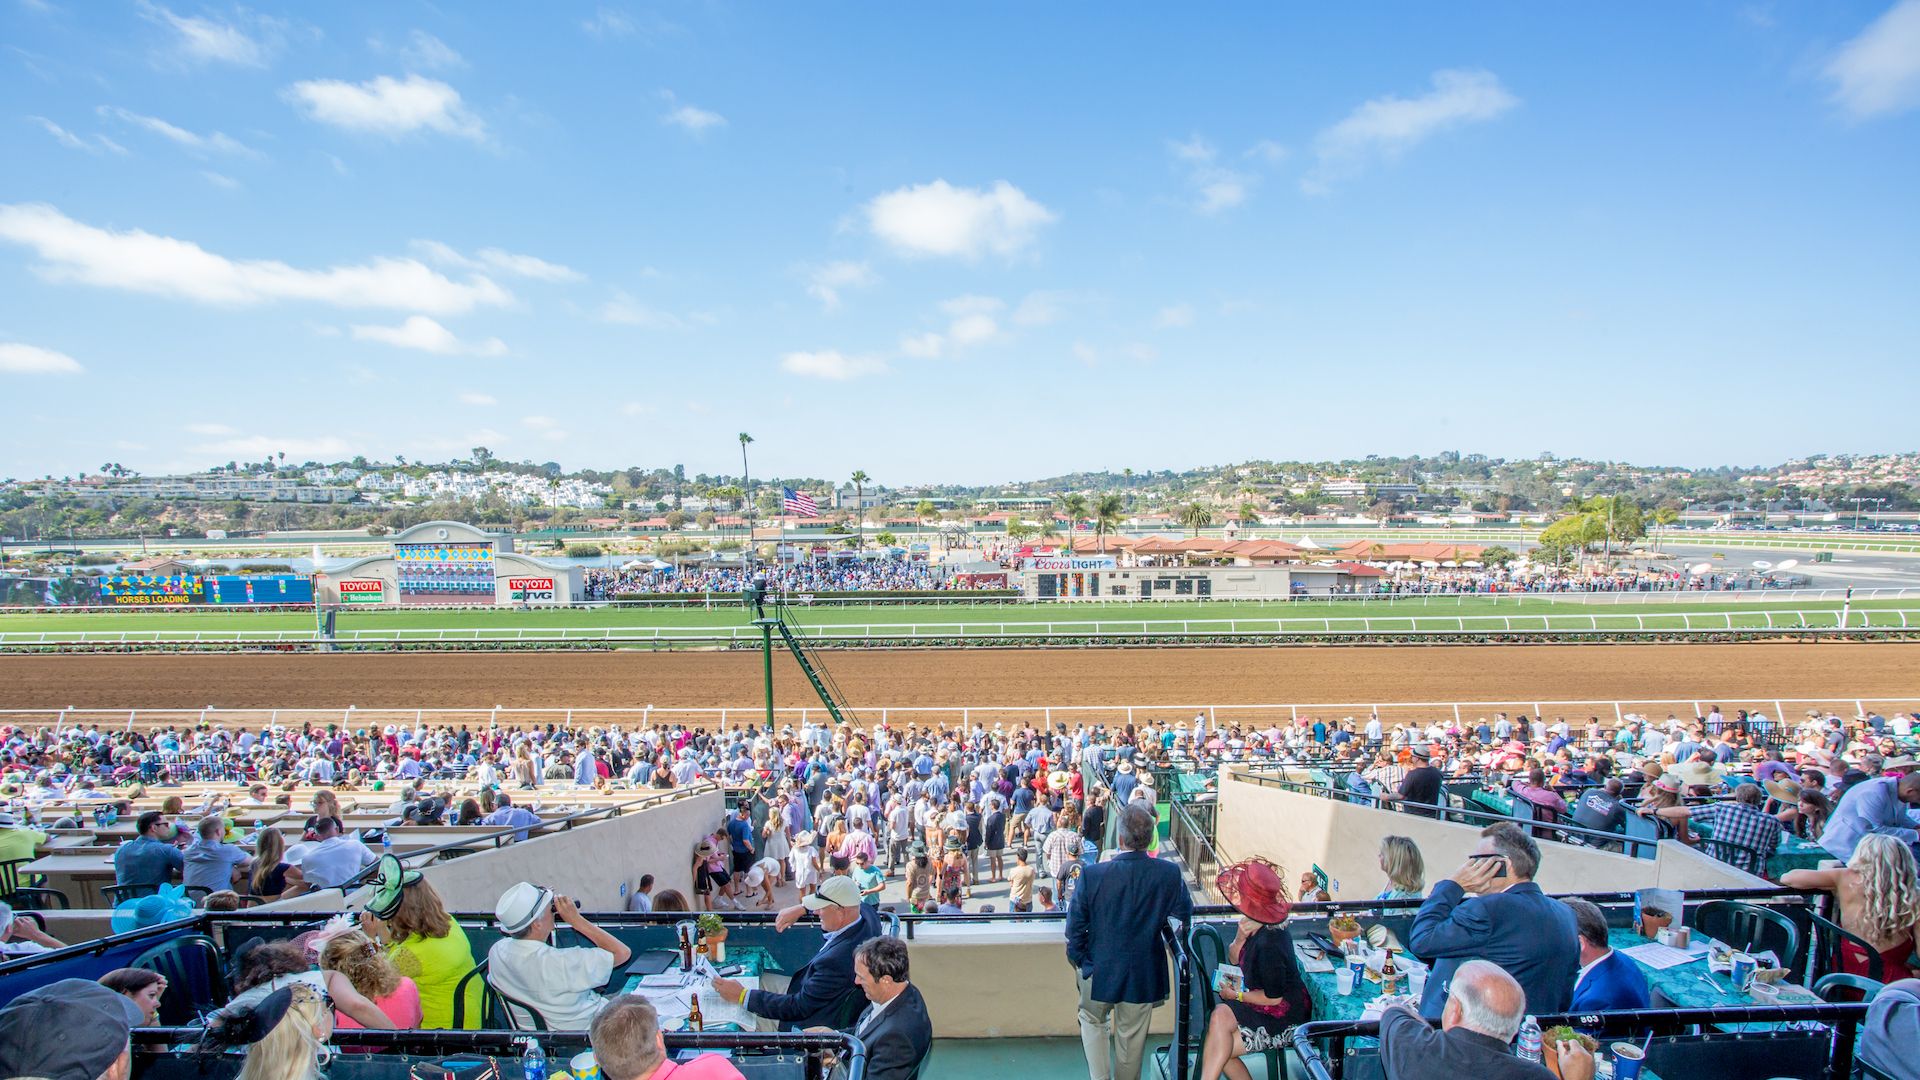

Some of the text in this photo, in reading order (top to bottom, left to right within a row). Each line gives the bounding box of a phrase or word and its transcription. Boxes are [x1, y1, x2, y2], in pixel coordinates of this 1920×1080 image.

[1035, 559, 1102, 569] Coors LIGHT
[341, 582, 381, 591] TOYOTA
[510, 580, 552, 589] TOYOTA
[116, 595, 190, 604] HORSES LOADING
[526, 592, 552, 600] TVG
[1580, 1015, 1599, 1023] 803
